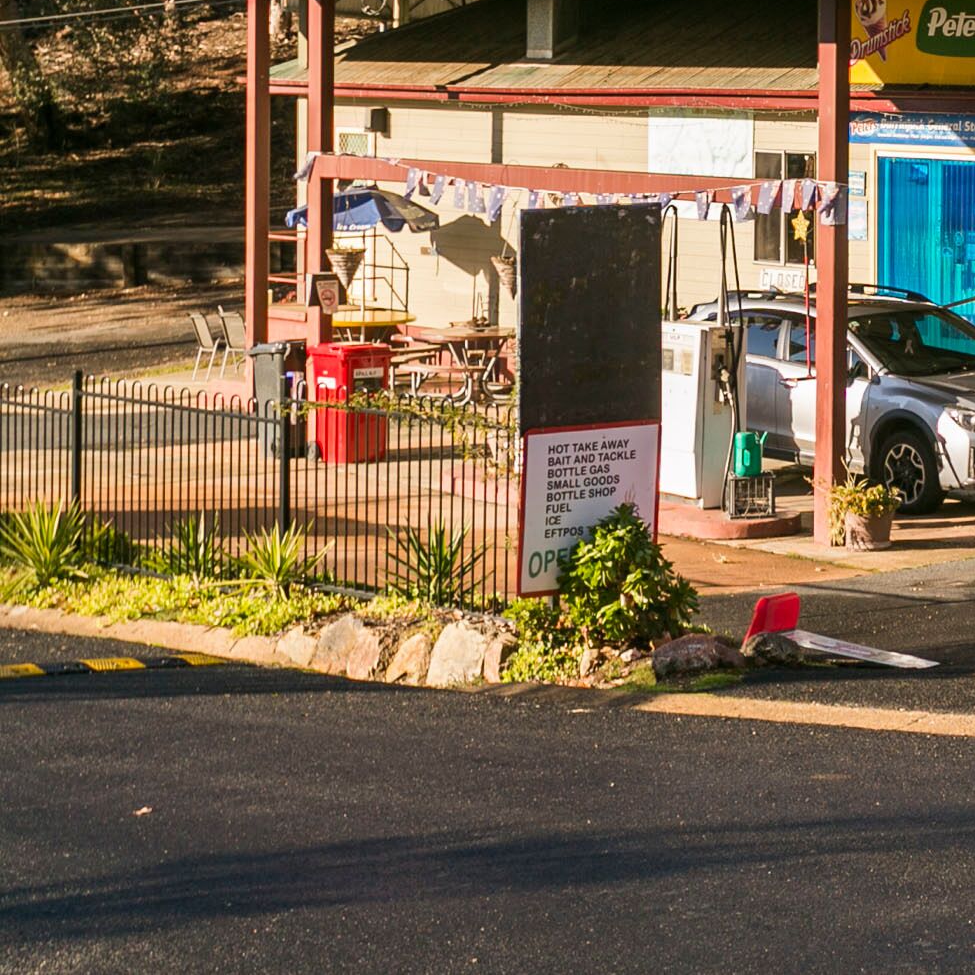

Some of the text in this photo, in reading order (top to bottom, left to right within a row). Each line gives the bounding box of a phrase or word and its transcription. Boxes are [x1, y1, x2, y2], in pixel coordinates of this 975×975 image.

[850, 10, 912, 62] Drumstick
[928, 119, 962, 132] General
[548, 439, 630, 455] HOT TAKE AWAY
[548, 450, 637, 467] BAIT AND TACKLE
[547, 464, 610, 478] BOTTLE GAS
[547, 475, 620, 490] SMALL GOODS
[546, 486, 616, 502] BOTTLE SHOP
[546, 503, 572, 514] FUEL
[545, 516, 562, 526] ICE
[544, 526, 584, 538] EFTPOS
[528, 548, 569, 578] OPE
